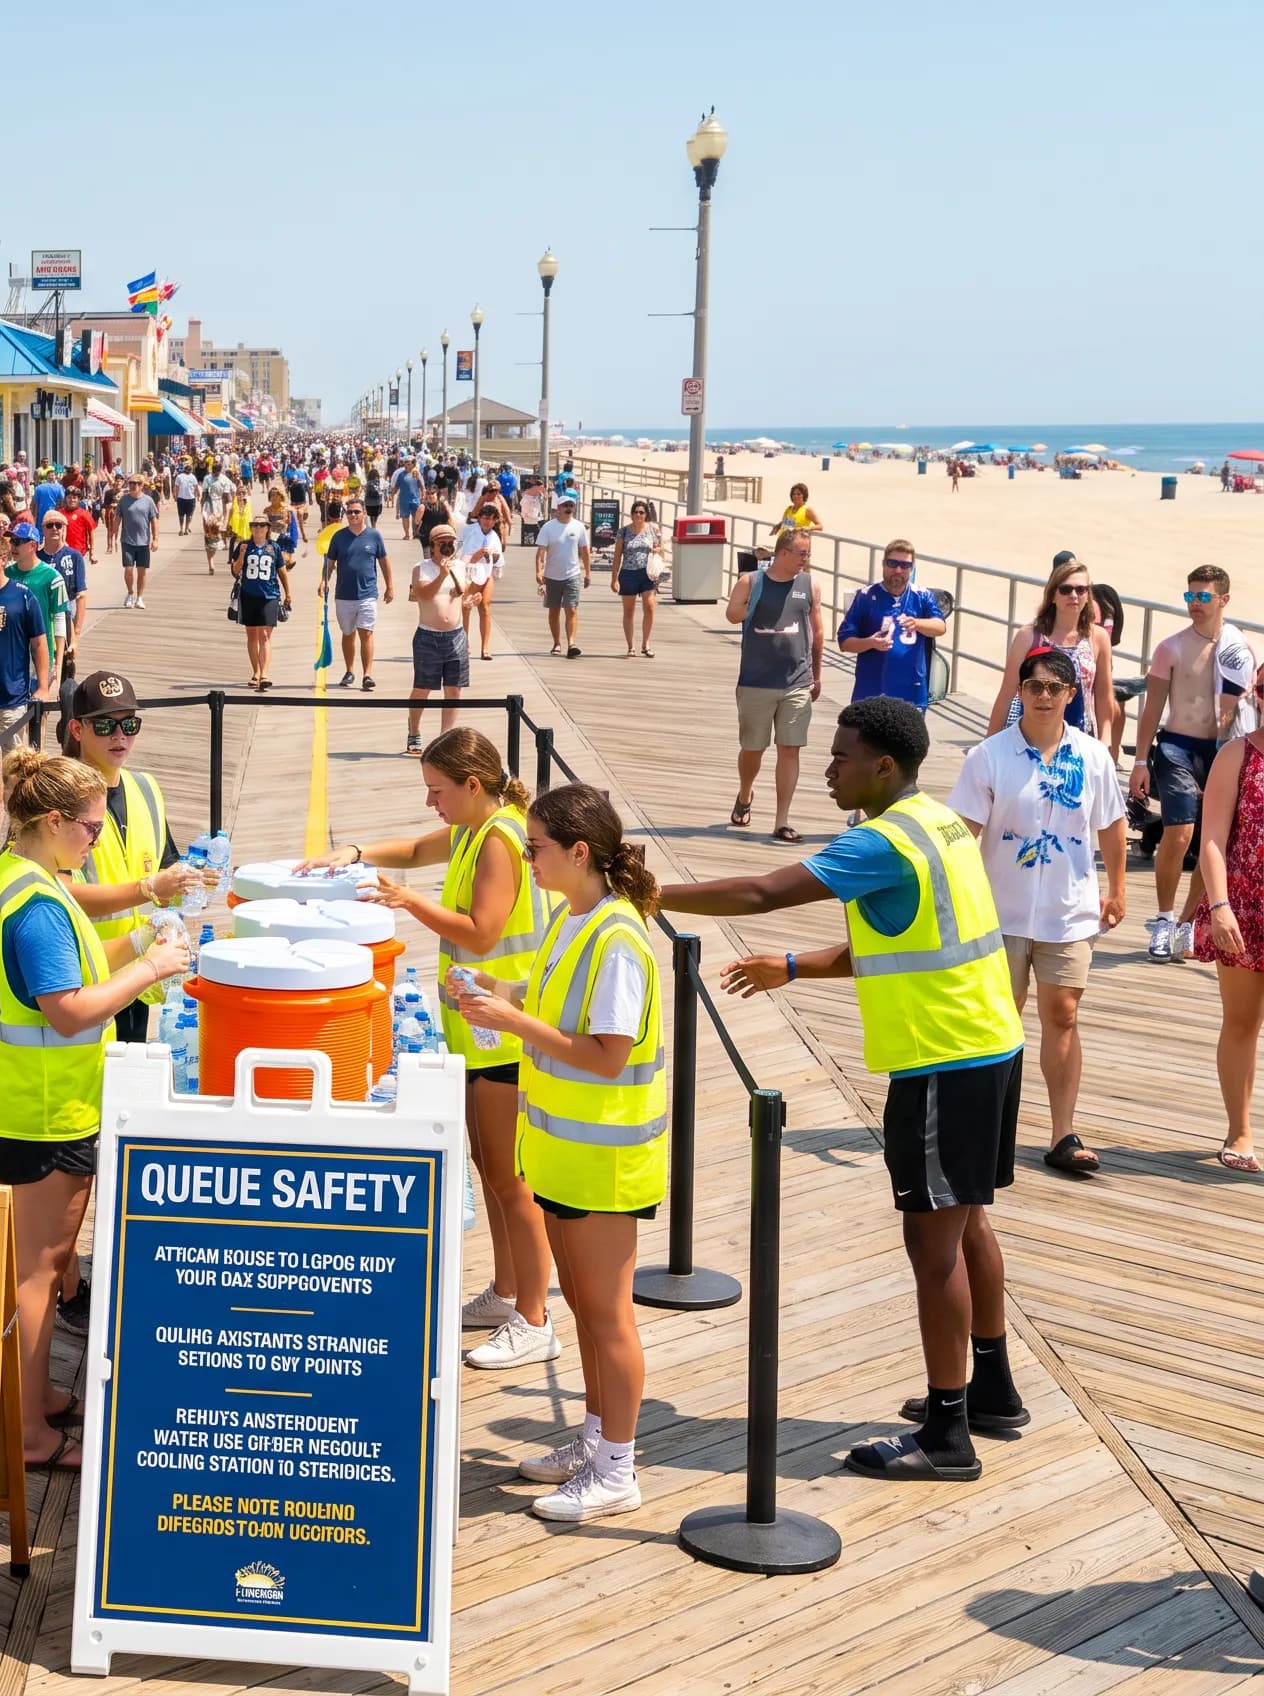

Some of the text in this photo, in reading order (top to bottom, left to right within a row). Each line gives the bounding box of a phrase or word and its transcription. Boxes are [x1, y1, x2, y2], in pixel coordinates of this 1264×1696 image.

[246, 554, 273, 581] 89
[141, 1162, 416, 1214] QUEUE SAFETY
[175, 1268, 217, 1286] YOUR
[178, 1349, 243, 1369] SETIONS
[304, 1357, 362, 1377] POINTS
[154, 1429, 209, 1448] WATER
[213, 1432, 244, 1450] USE
[137, 1450, 205, 1471] COOLING
[209, 1455, 274, 1475] STATION
[172, 1493, 233, 1513] PLEASE
[237, 1497, 280, 1516] NOTE
